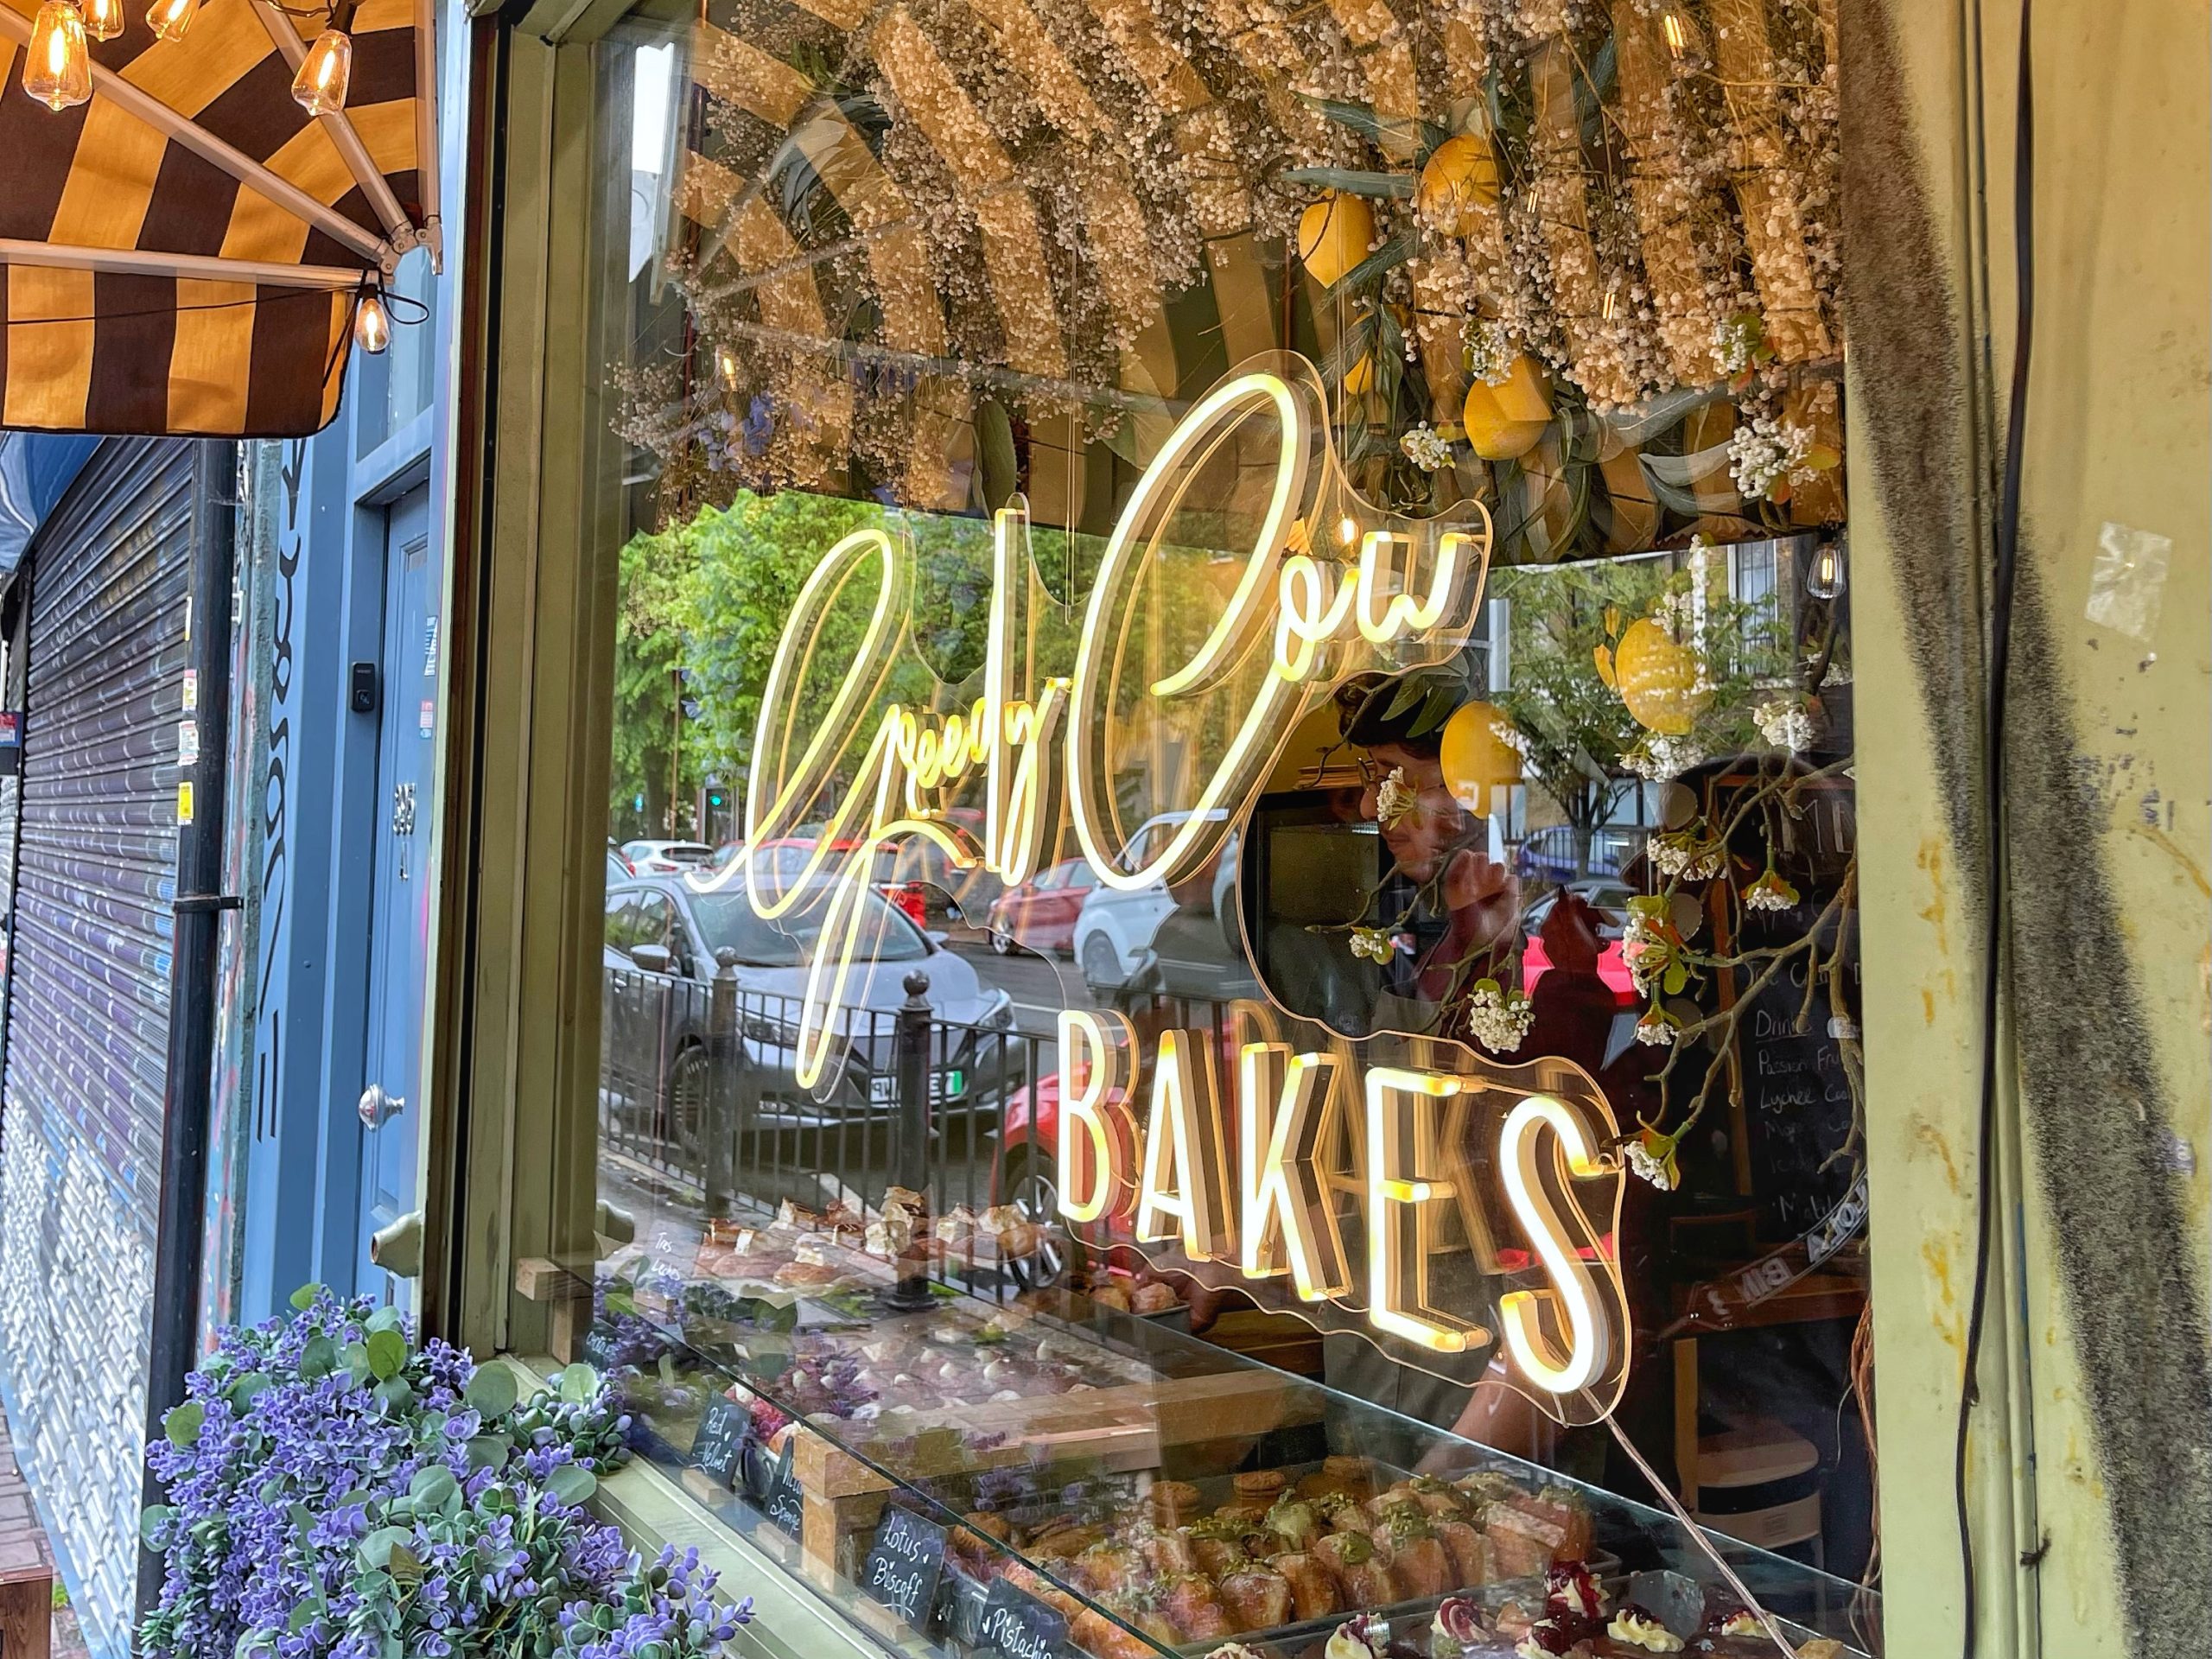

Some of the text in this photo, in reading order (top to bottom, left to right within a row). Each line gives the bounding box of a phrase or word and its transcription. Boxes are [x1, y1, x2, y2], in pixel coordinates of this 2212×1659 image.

[1068, 372, 1479, 892] Cow
[1057, 1009, 1611, 1394] BAKES
[705, 1407, 728, 1436] Red
[700, 1441, 733, 1472] Velvet
[883, 1510, 921, 1562] Lotus
[873, 1556, 923, 1607] Biscoff
